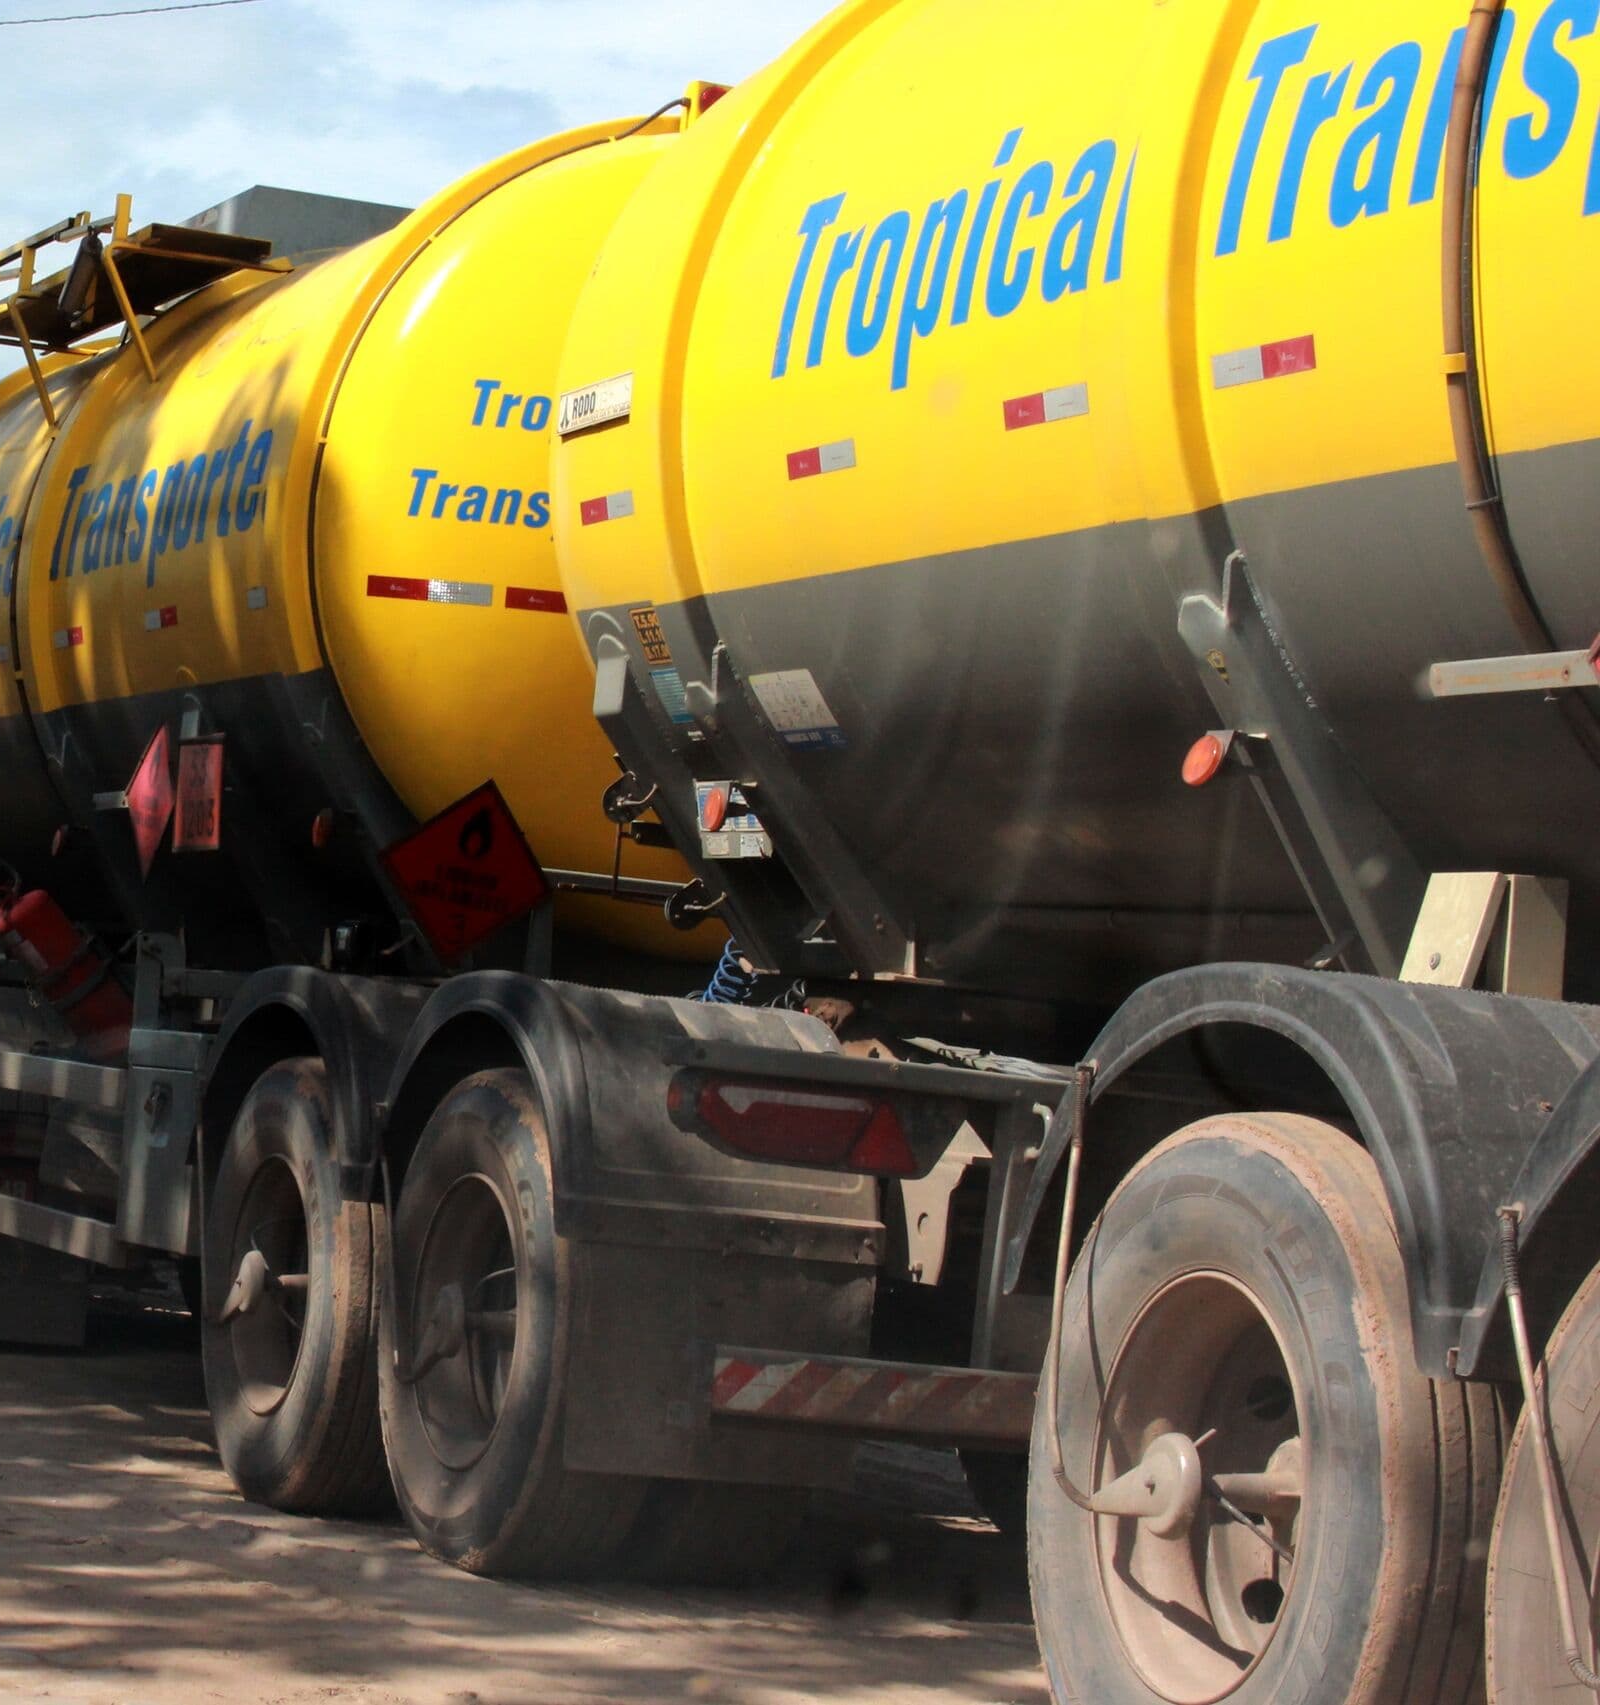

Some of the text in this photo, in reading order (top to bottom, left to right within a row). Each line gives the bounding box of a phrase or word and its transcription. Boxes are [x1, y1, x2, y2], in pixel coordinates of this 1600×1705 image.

[1215, 0, 1600, 258] Trans
[472, 379, 552, 432] Tro
[49, 418, 273, 590] Transporte
[407, 468, 551, 529] Trans
